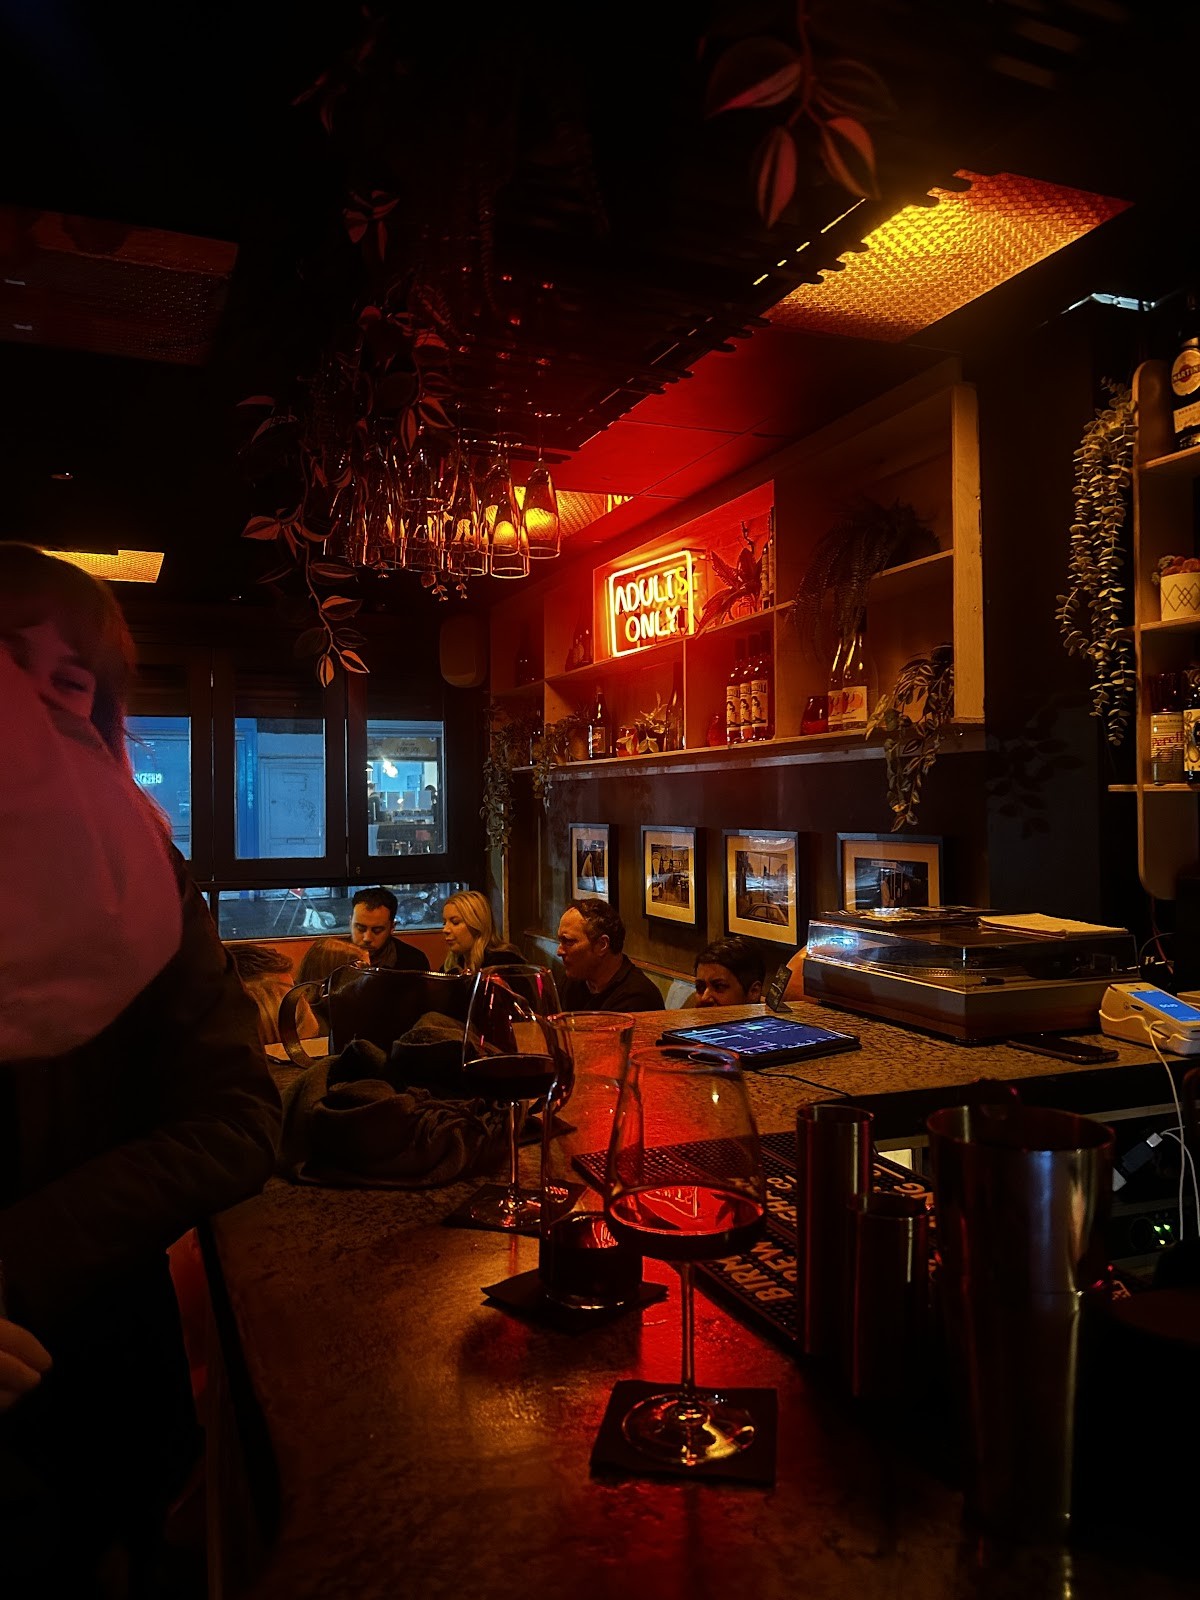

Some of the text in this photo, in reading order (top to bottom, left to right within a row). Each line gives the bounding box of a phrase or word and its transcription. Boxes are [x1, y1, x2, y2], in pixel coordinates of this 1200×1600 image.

[1173, 365, 1200, 382] MARTIN
[615, 567, 689, 615] ADULTS
[625, 605, 681, 642] ONLY
